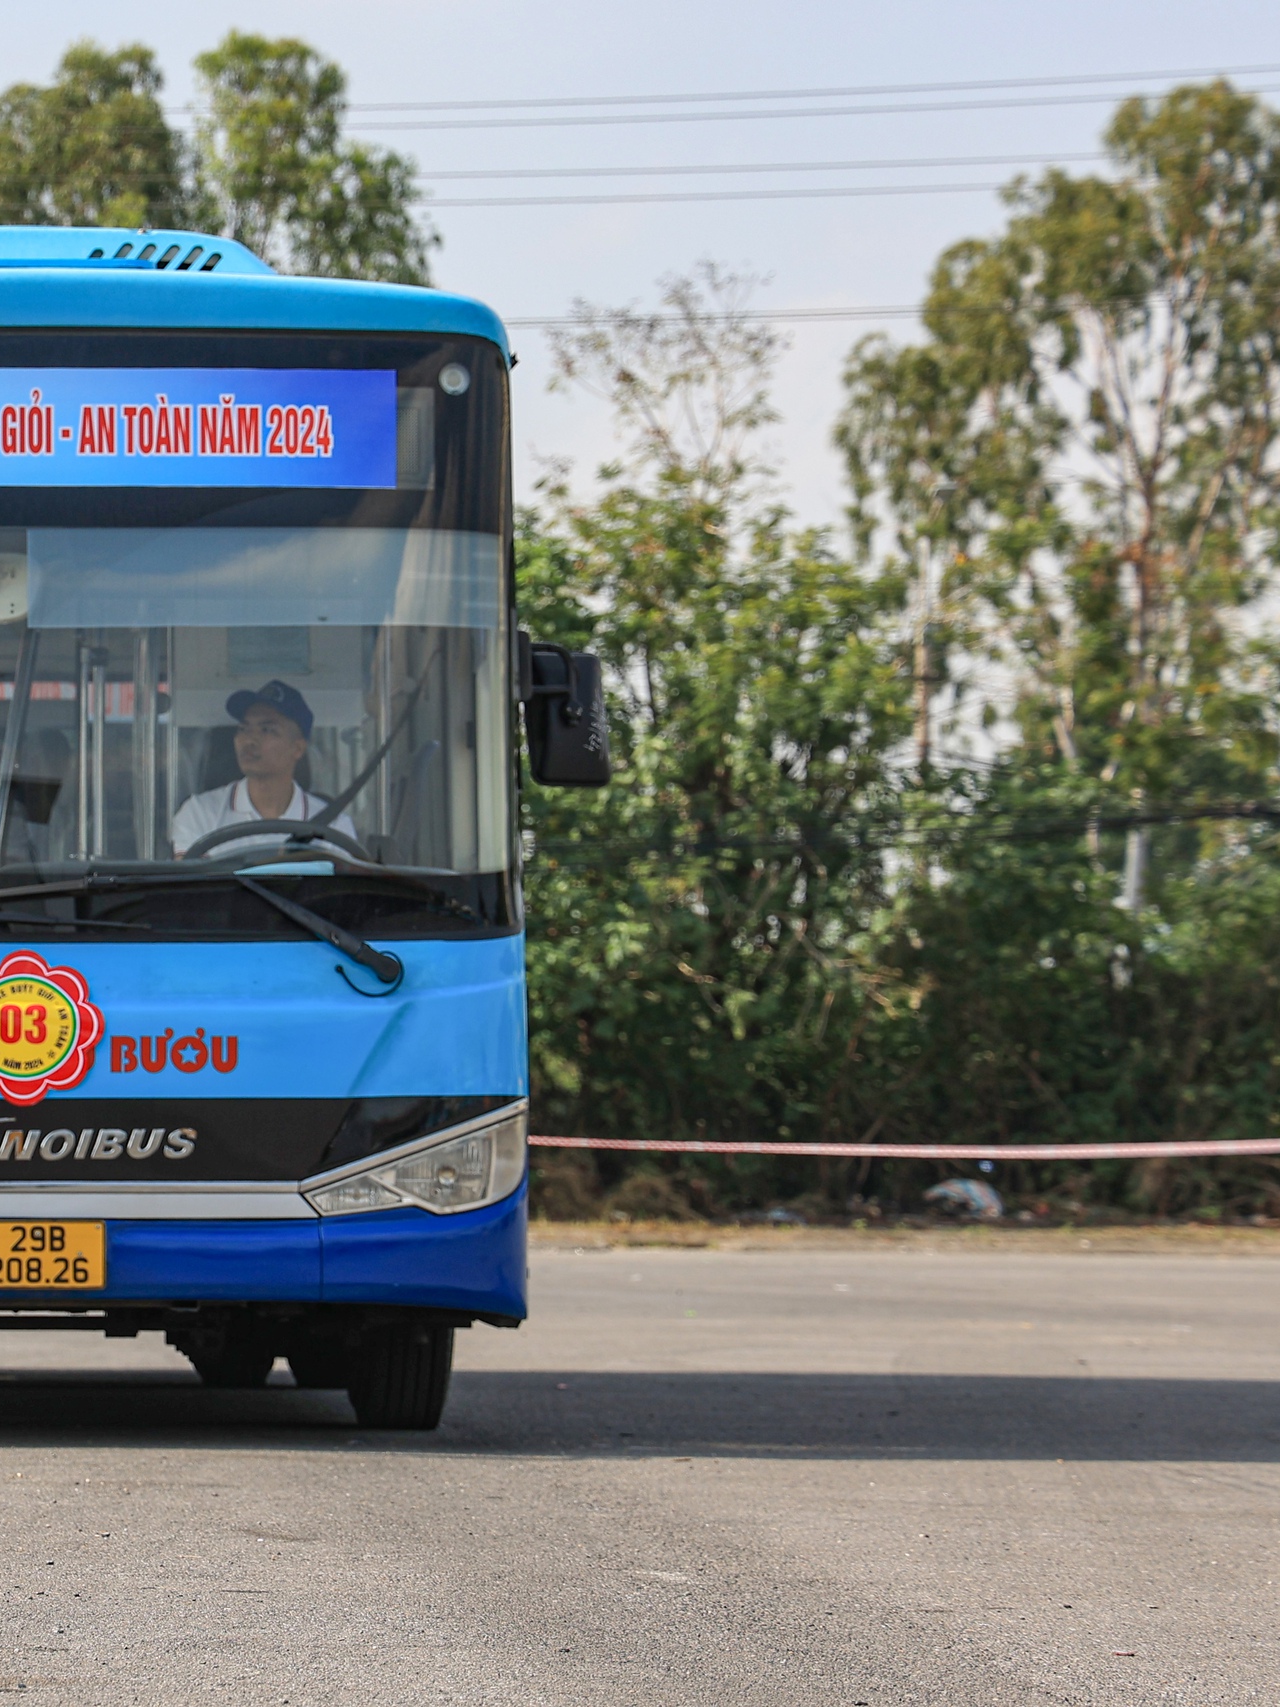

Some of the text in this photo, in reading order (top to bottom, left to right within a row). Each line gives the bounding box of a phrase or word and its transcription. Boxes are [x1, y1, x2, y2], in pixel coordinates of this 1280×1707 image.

[1, 389, 53, 455] GIỎI
[79, 405, 116, 455] AN
[123, 396, 192, 455] TOÀN
[199, 396, 261, 455] NĂM
[267, 406, 333, 457] 2024
[0, 1005, 47, 1043] 03
[11, 1226, 65, 1252] 29B
